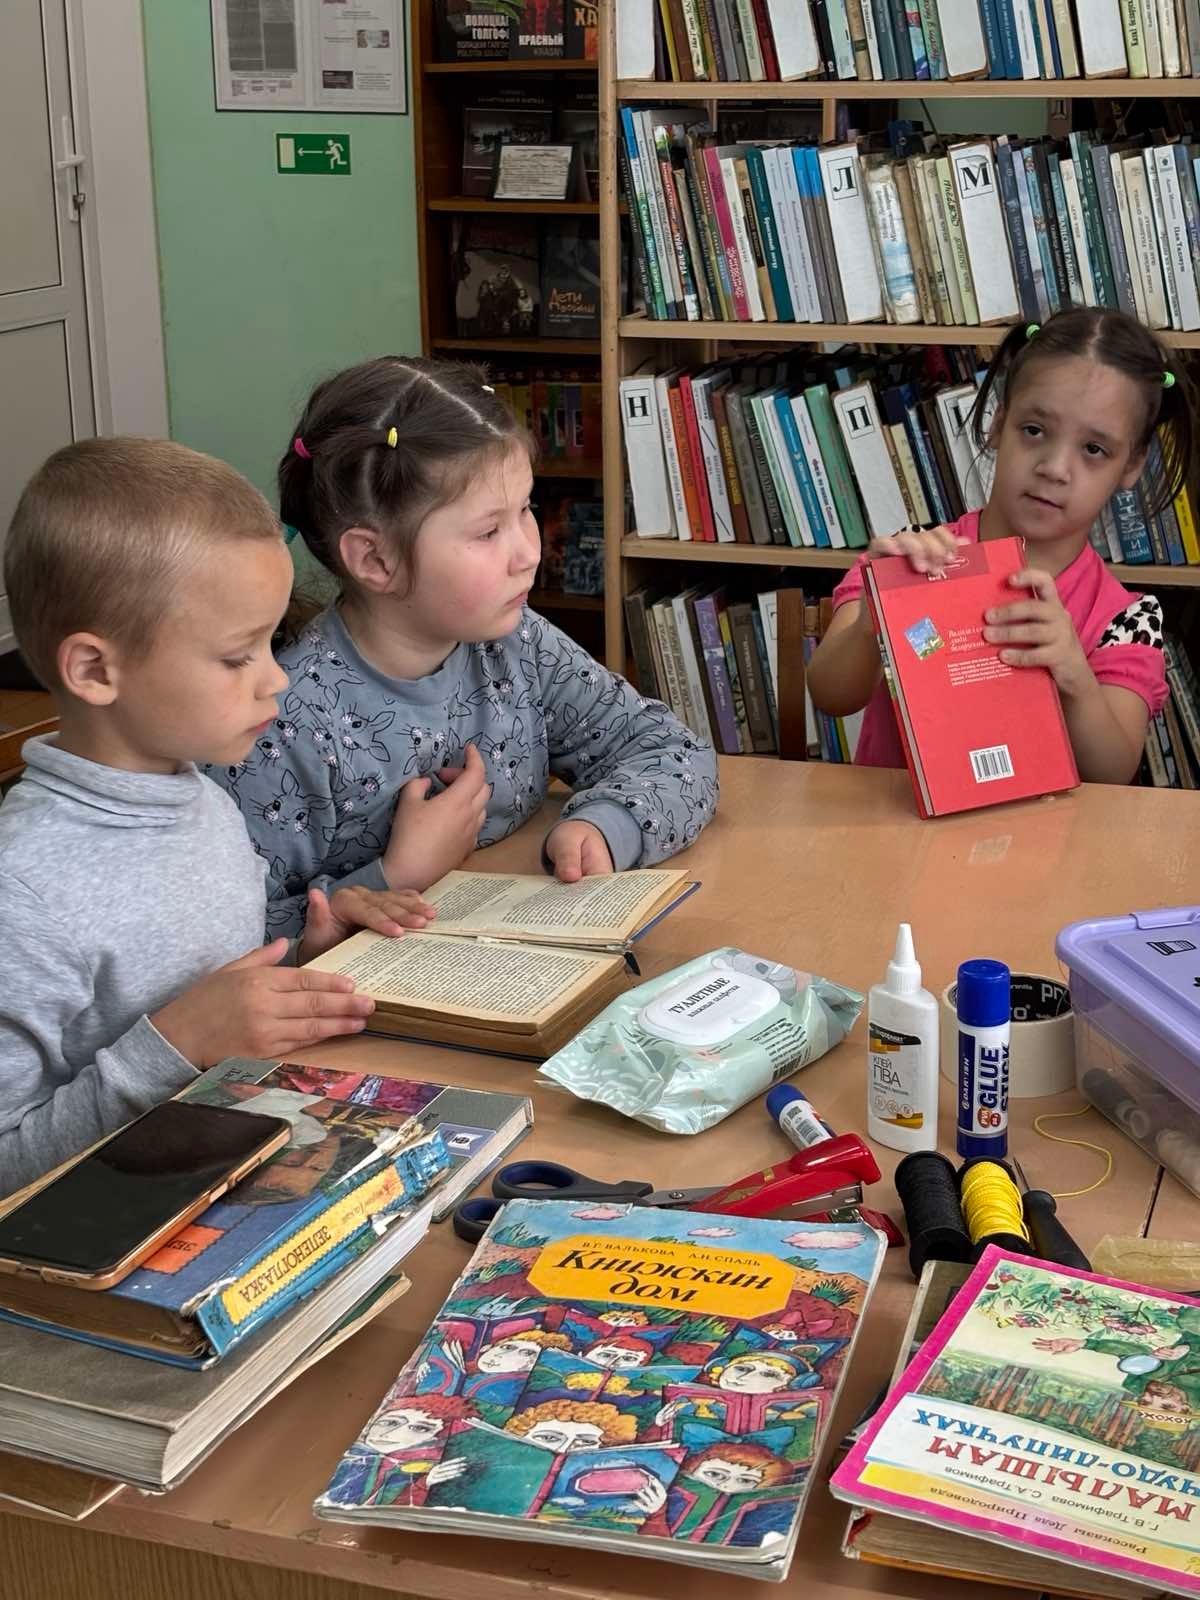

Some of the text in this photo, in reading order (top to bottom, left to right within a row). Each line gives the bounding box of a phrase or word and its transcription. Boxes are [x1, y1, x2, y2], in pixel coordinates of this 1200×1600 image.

[519, 32, 564, 46] КРАСНЫЙ
[832, 165, 855, 193] Л
[960, 162, 993, 192] М
[639, 203, 651, 235] Сказки
[628, 395, 649, 419] Н
[847, 405, 873, 432] П
[668, 976, 731, 1014] ТУАЛЕТНЫЕ
[872, 1055, 892, 1070] КЛЕЙ
[873, 1063, 902, 1088] ПВА
[979, 1047, 1000, 1109] GLUE
[238, 1223, 332, 1305] ЗЕЛЕНОГЛАЗКА
[552, 1249, 774, 1290] Книжкин
[608, 1273, 698, 1303] дом
[912, 1407, 1200, 1497] ЧУДО-ЛИПУЧКАХ
[926, 1434, 1198, 1522] МАЛЫШАМ
[929, 1486, 1147, 1554] Рассказы Деда Природоведа
